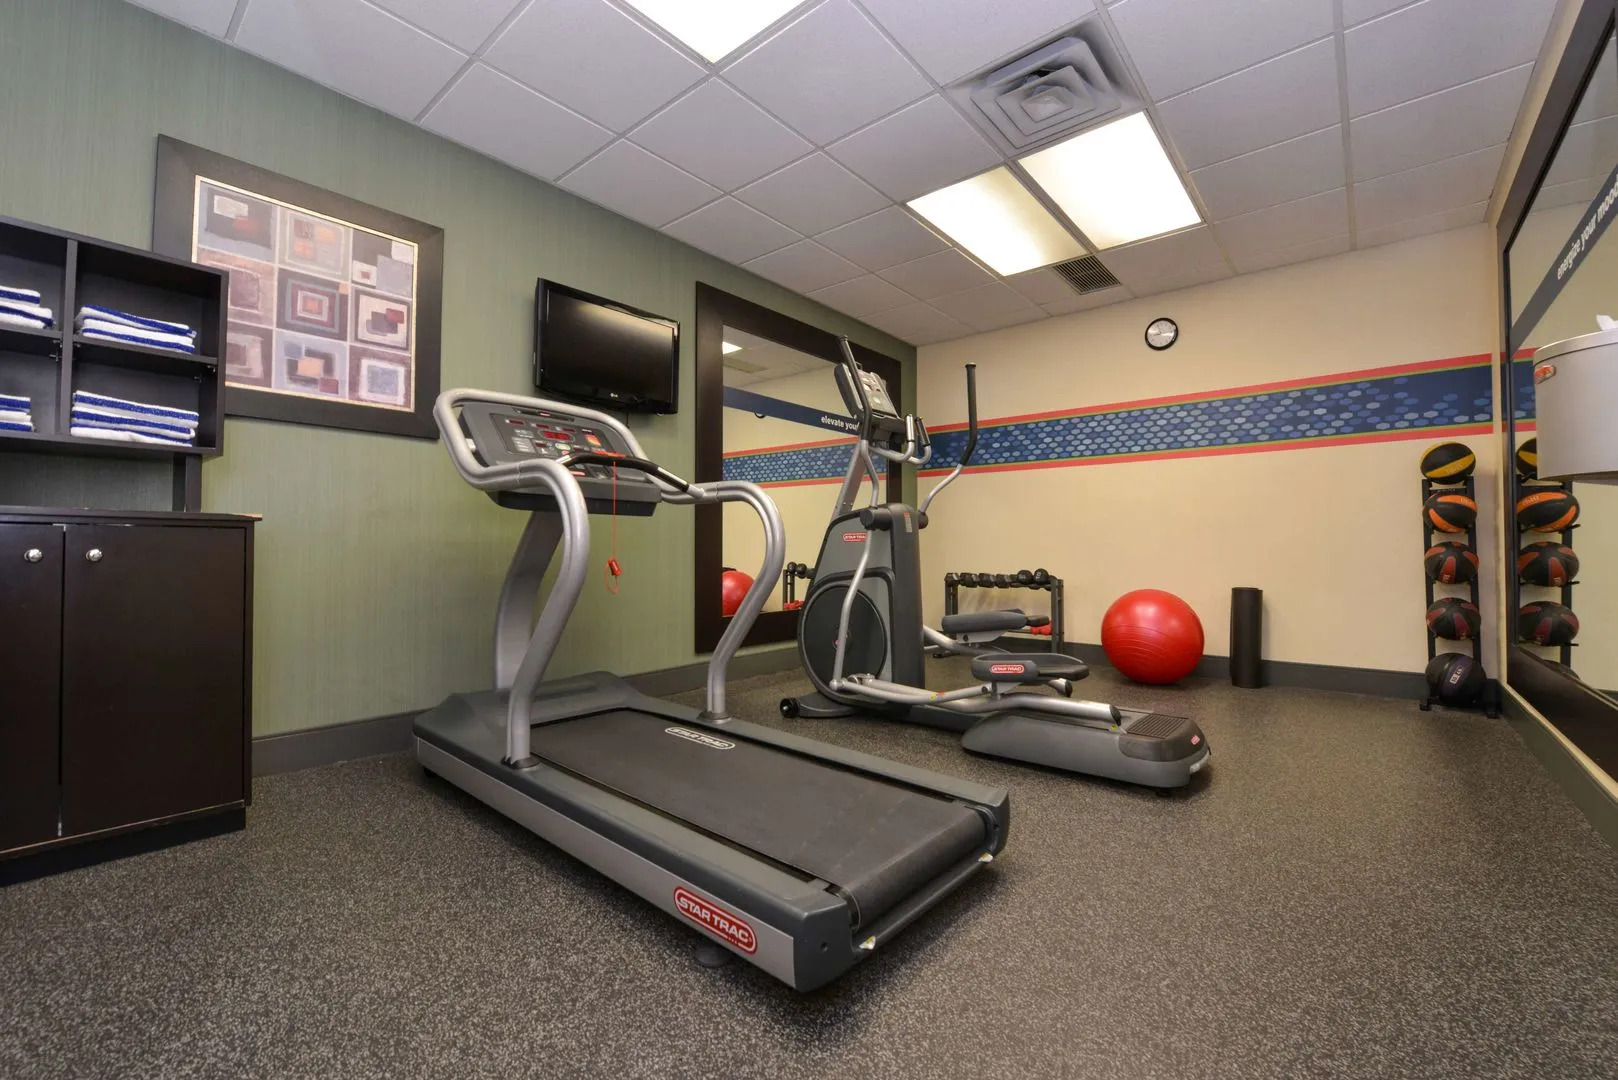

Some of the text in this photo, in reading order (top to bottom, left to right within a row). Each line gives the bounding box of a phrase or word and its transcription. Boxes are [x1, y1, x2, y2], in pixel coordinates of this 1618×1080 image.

[1556, 240, 1581, 280] energize
[1580, 214, 1597, 251] your
[821, 415, 860, 431] elevate you
[677, 895, 749, 943] STAR TRAC
